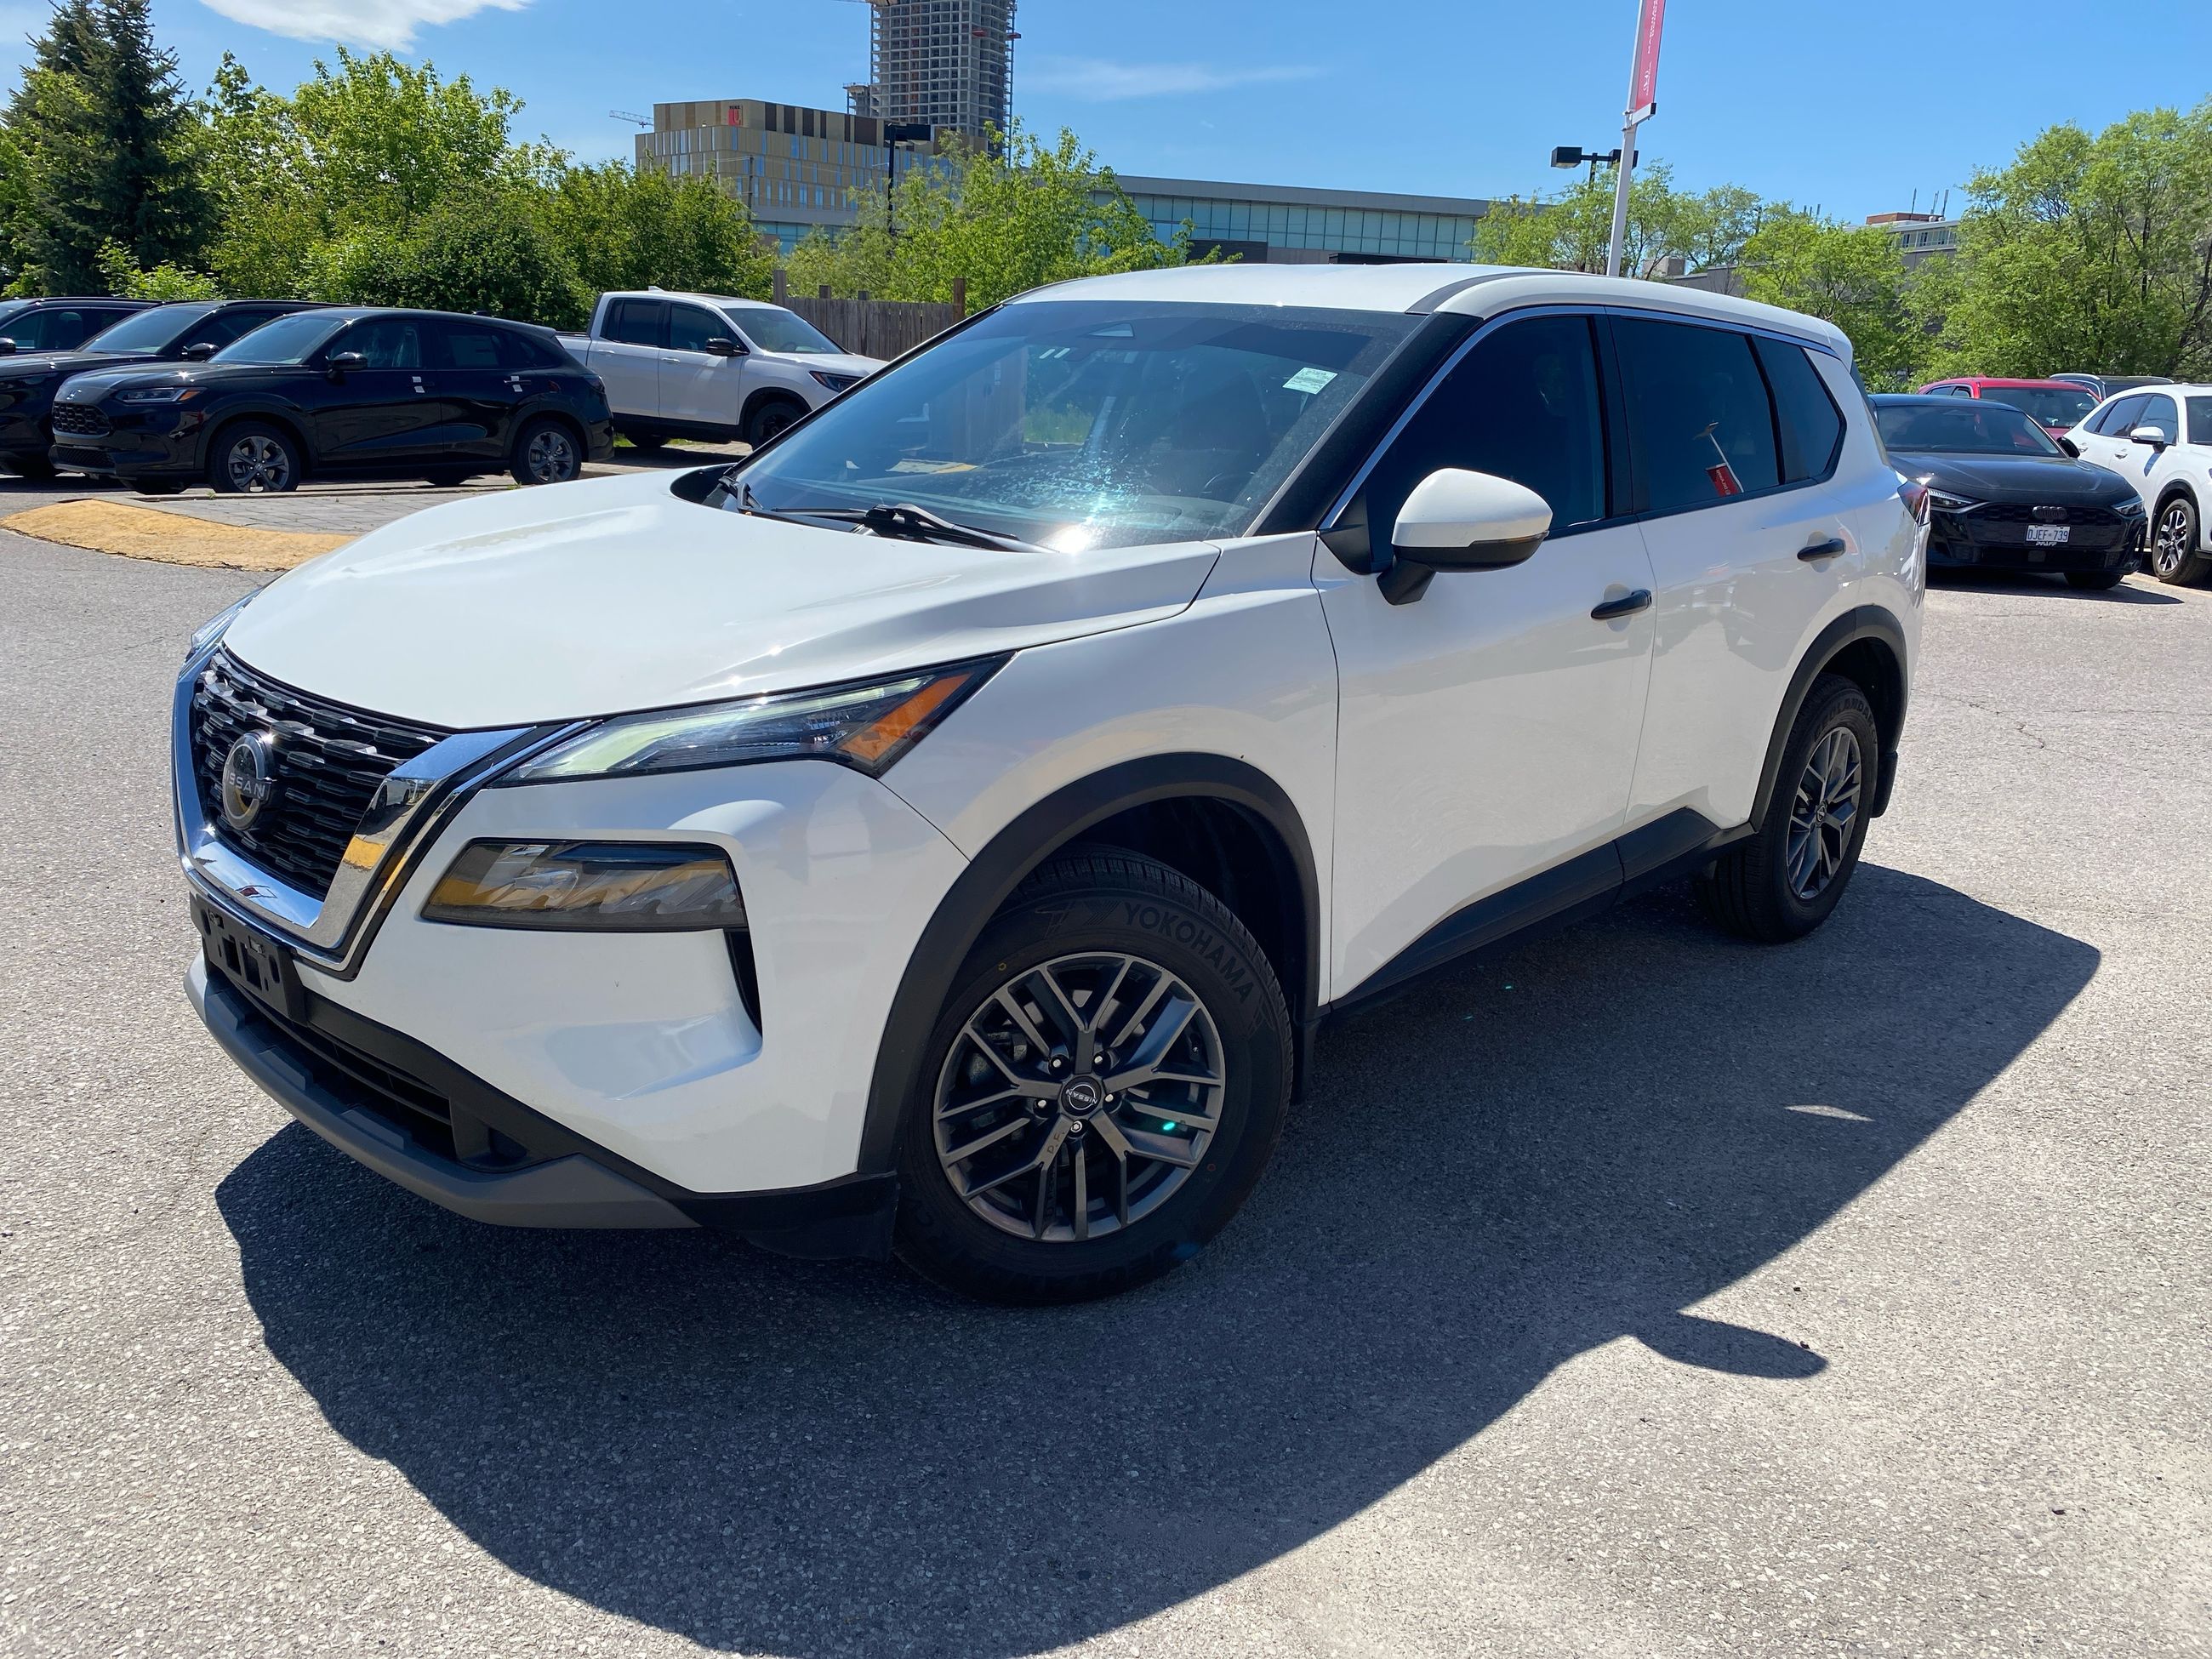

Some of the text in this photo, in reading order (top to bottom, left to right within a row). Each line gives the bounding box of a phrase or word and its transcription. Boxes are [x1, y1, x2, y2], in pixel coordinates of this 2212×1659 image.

[2027, 528, 2068, 541] DJEF 739
[1123, 902, 1254, 1003] YOKOHAMA
[1065, 1089, 1098, 1104] NISSAN
